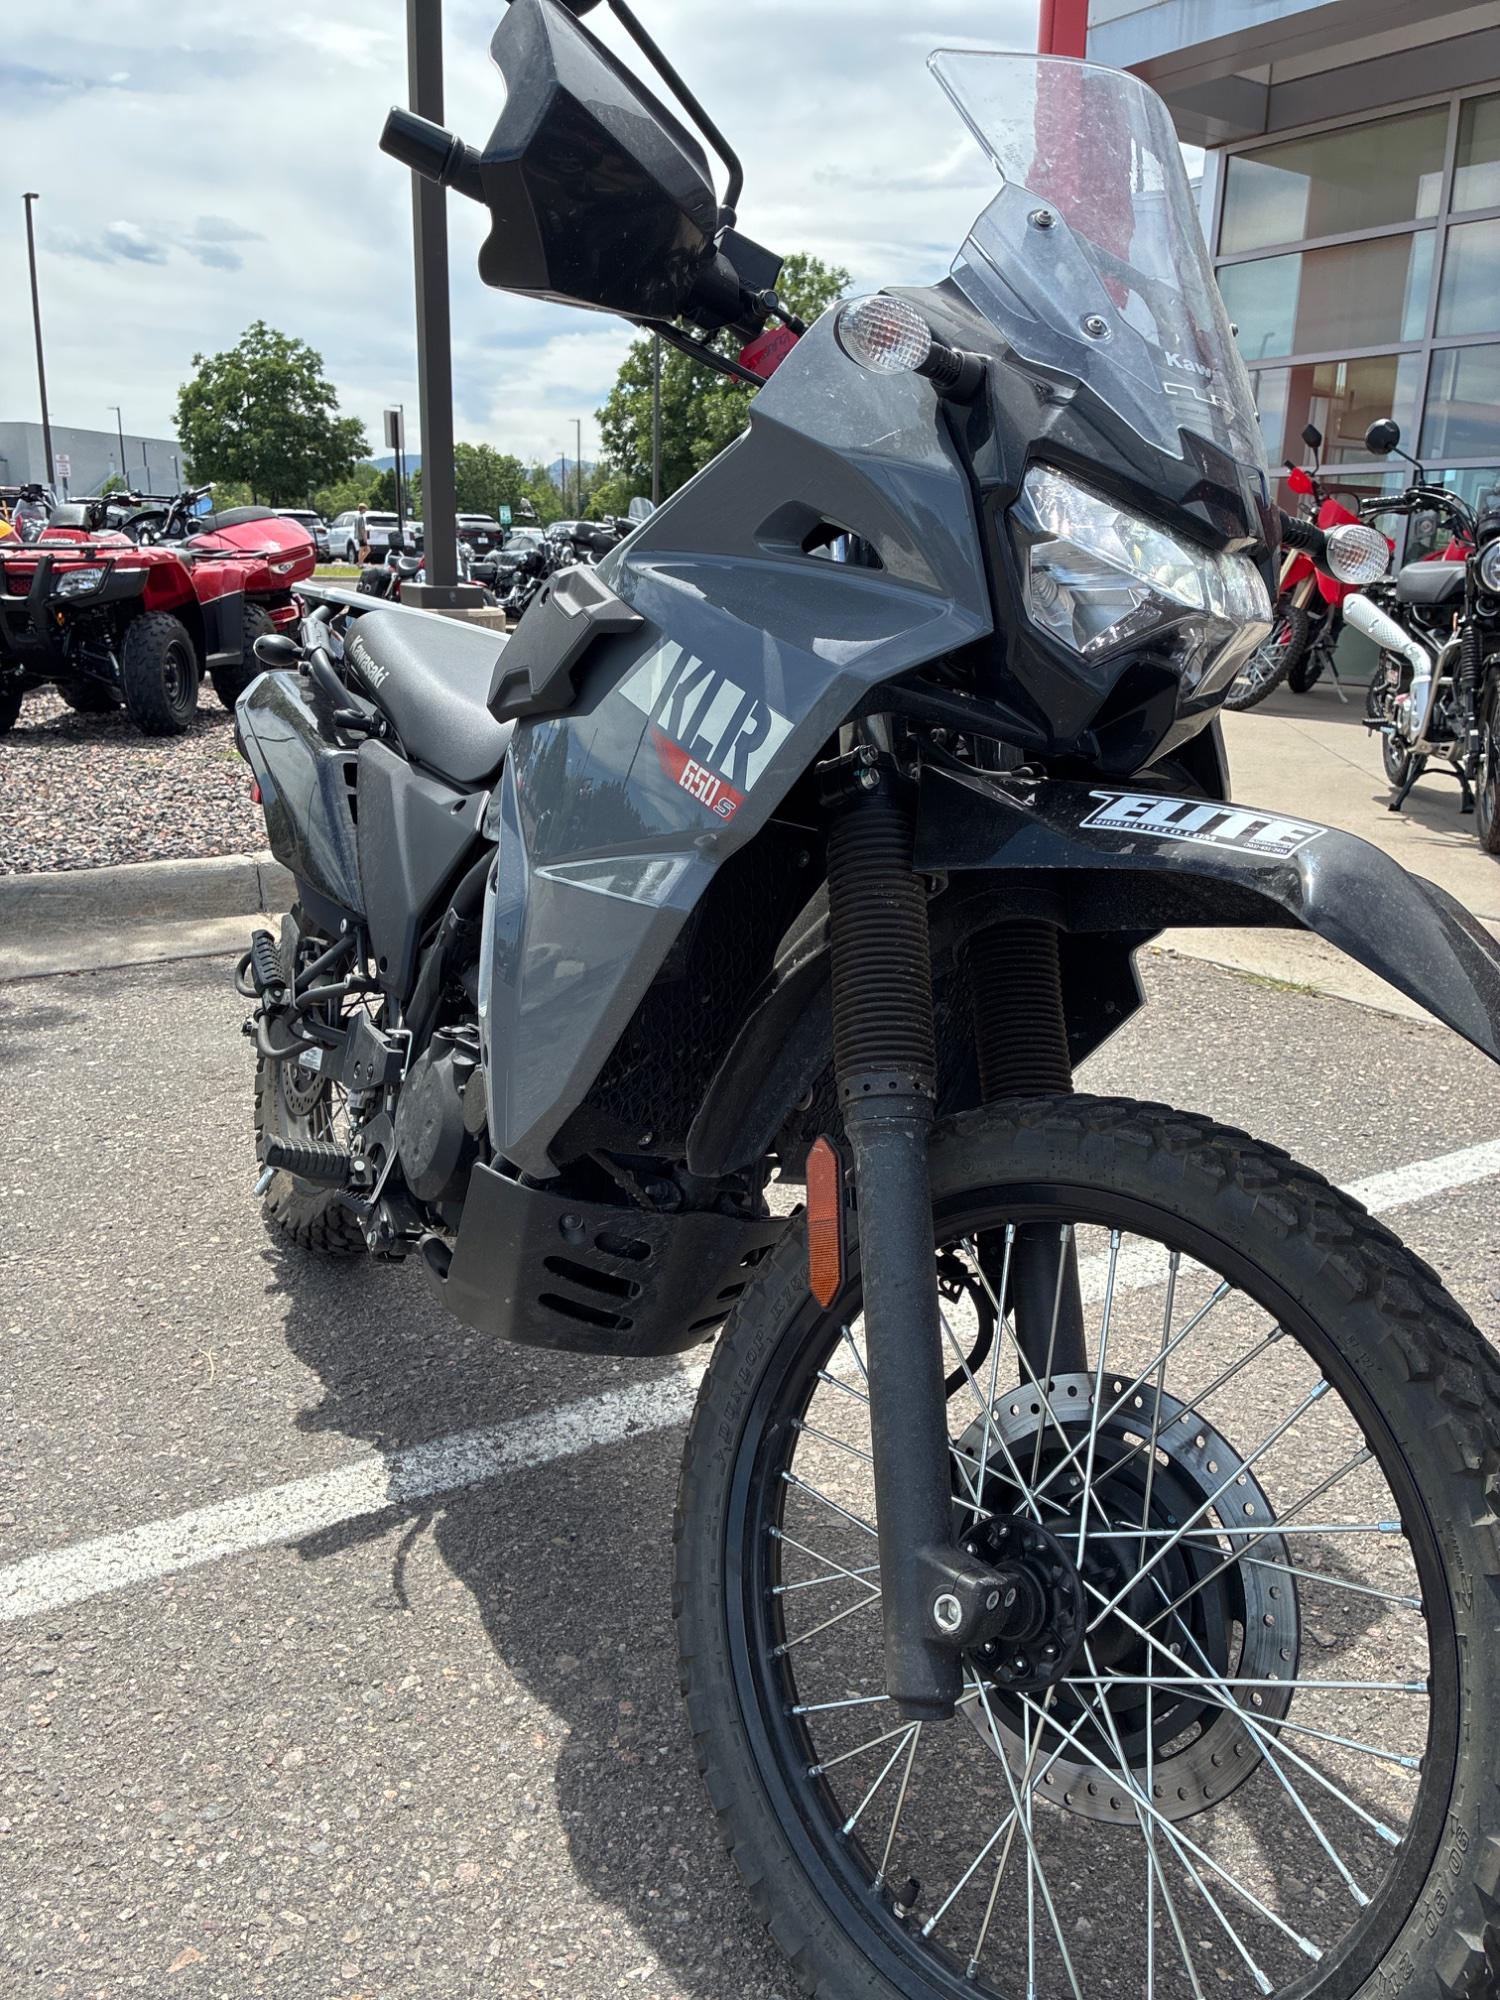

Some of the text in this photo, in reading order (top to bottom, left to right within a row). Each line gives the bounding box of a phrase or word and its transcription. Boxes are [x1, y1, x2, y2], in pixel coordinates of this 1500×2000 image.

[349, 634, 390, 689] Kawasaki
[648, 645, 775, 791] KLR
[679, 759, 737, 818] 650 S
[1095, 796, 1315, 849] ELITE
[718, 1329, 765, 1447] DUNLOP
